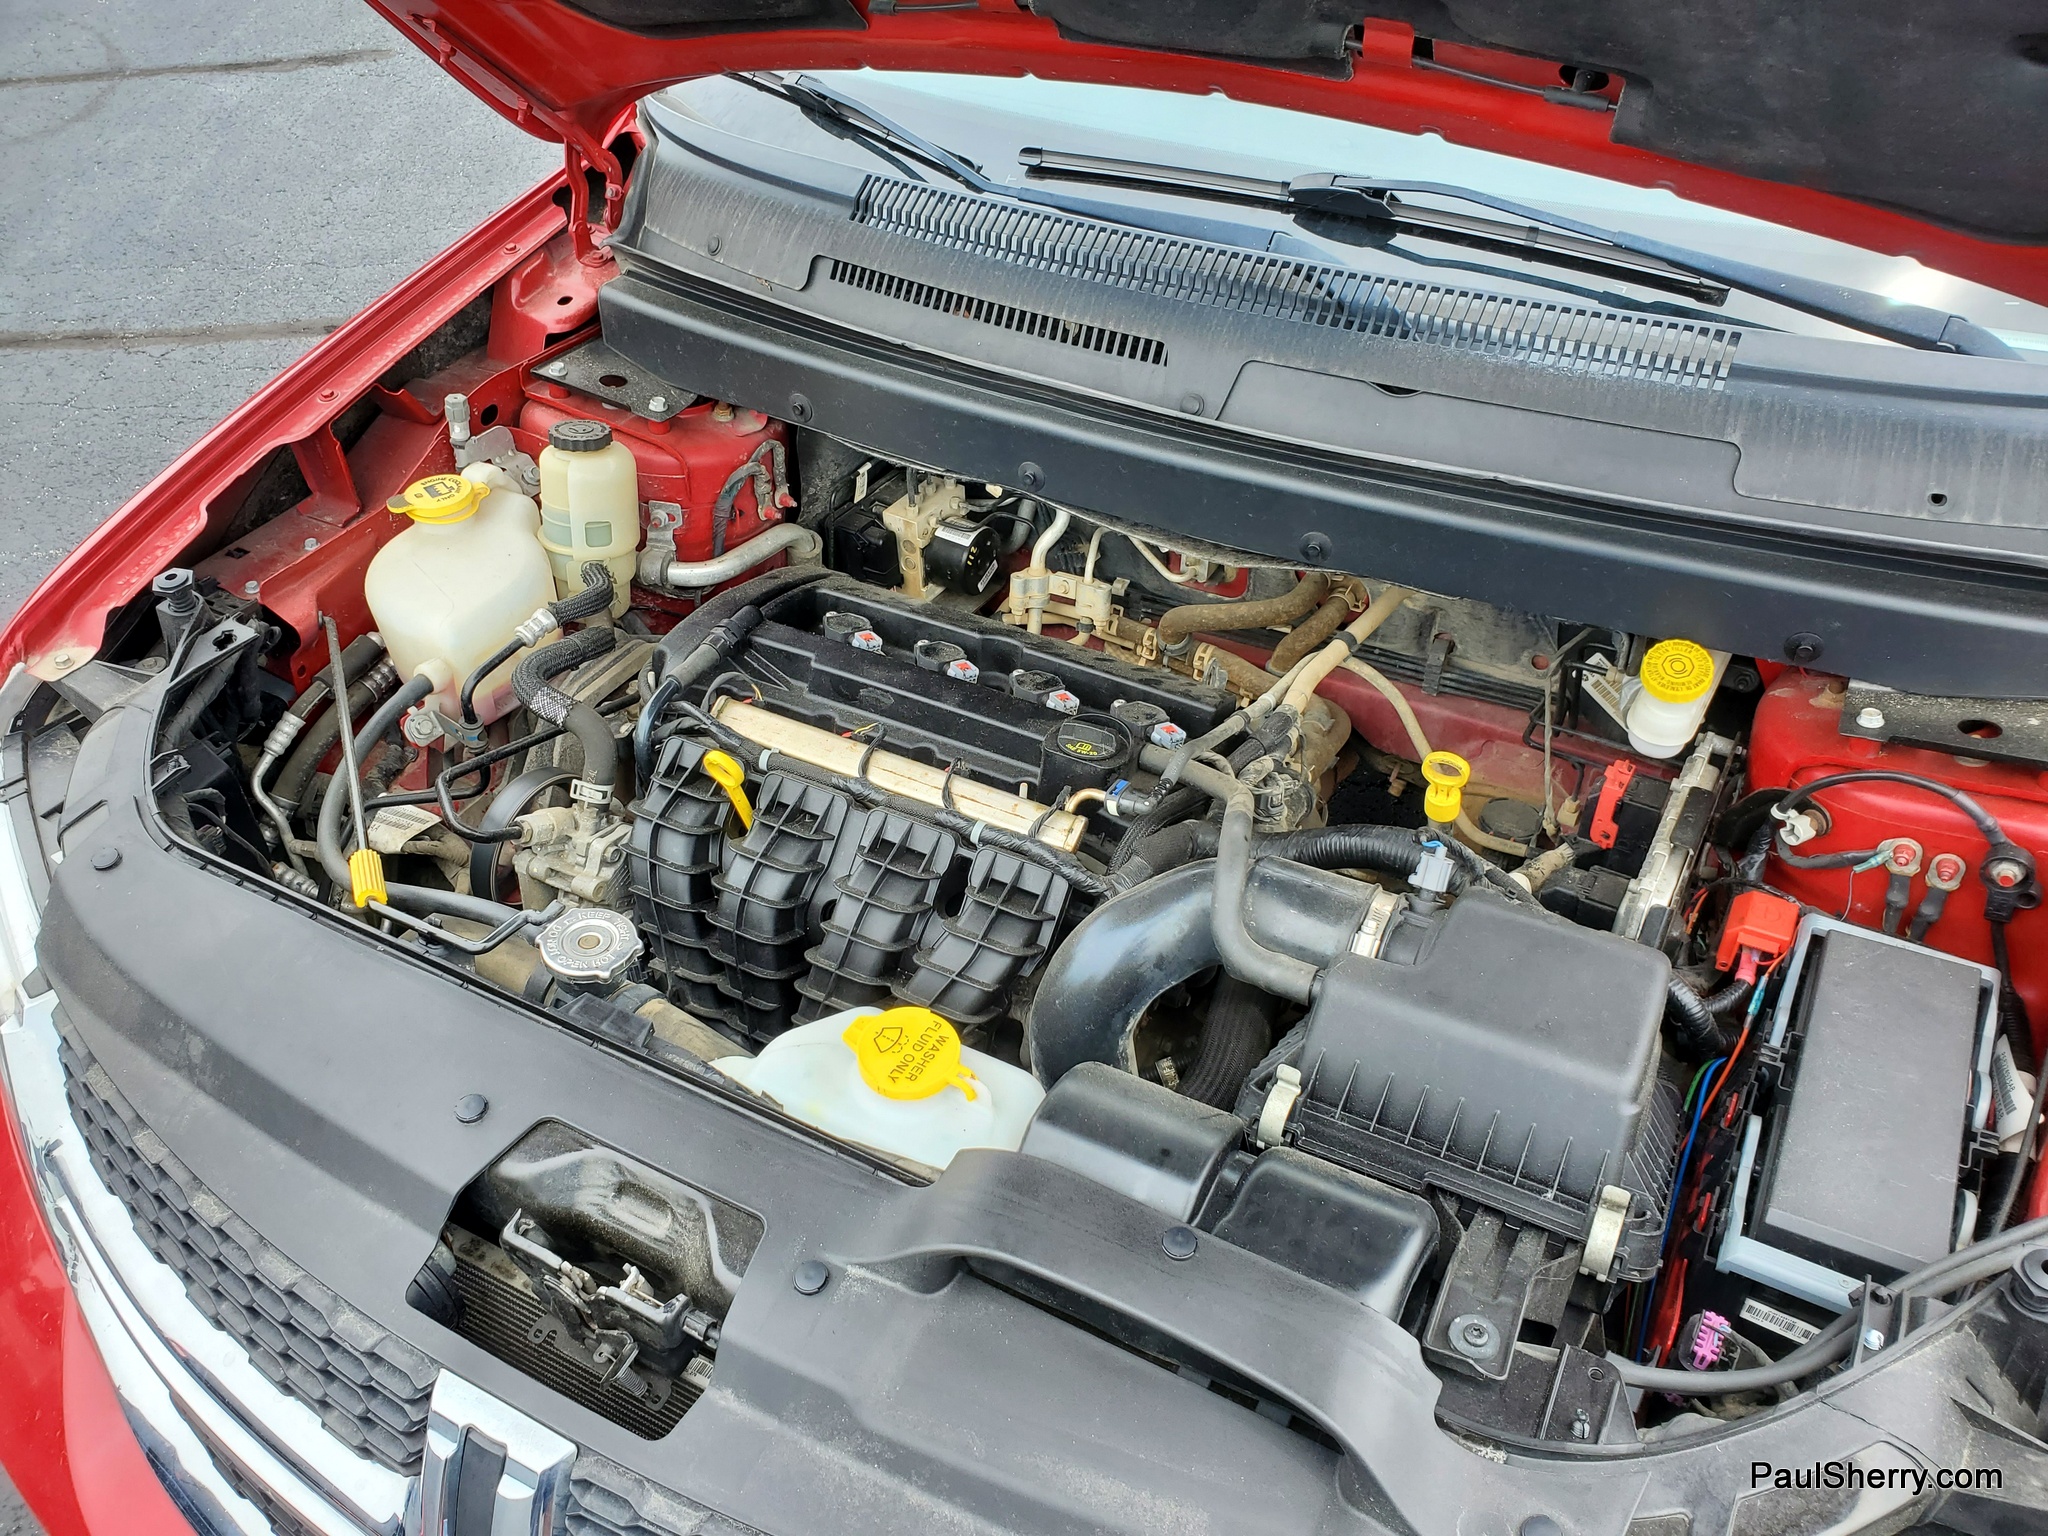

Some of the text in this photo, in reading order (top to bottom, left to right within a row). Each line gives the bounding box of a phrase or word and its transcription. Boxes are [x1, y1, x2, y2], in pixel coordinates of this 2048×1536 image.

[546, 925, 616, 969] DO NOT OPEN HOT
[578, 911, 630, 942] KEEP TIGHT
[888, 1020, 942, 1084] FLUID ONLY
[905, 1034, 950, 1082] WASHER
